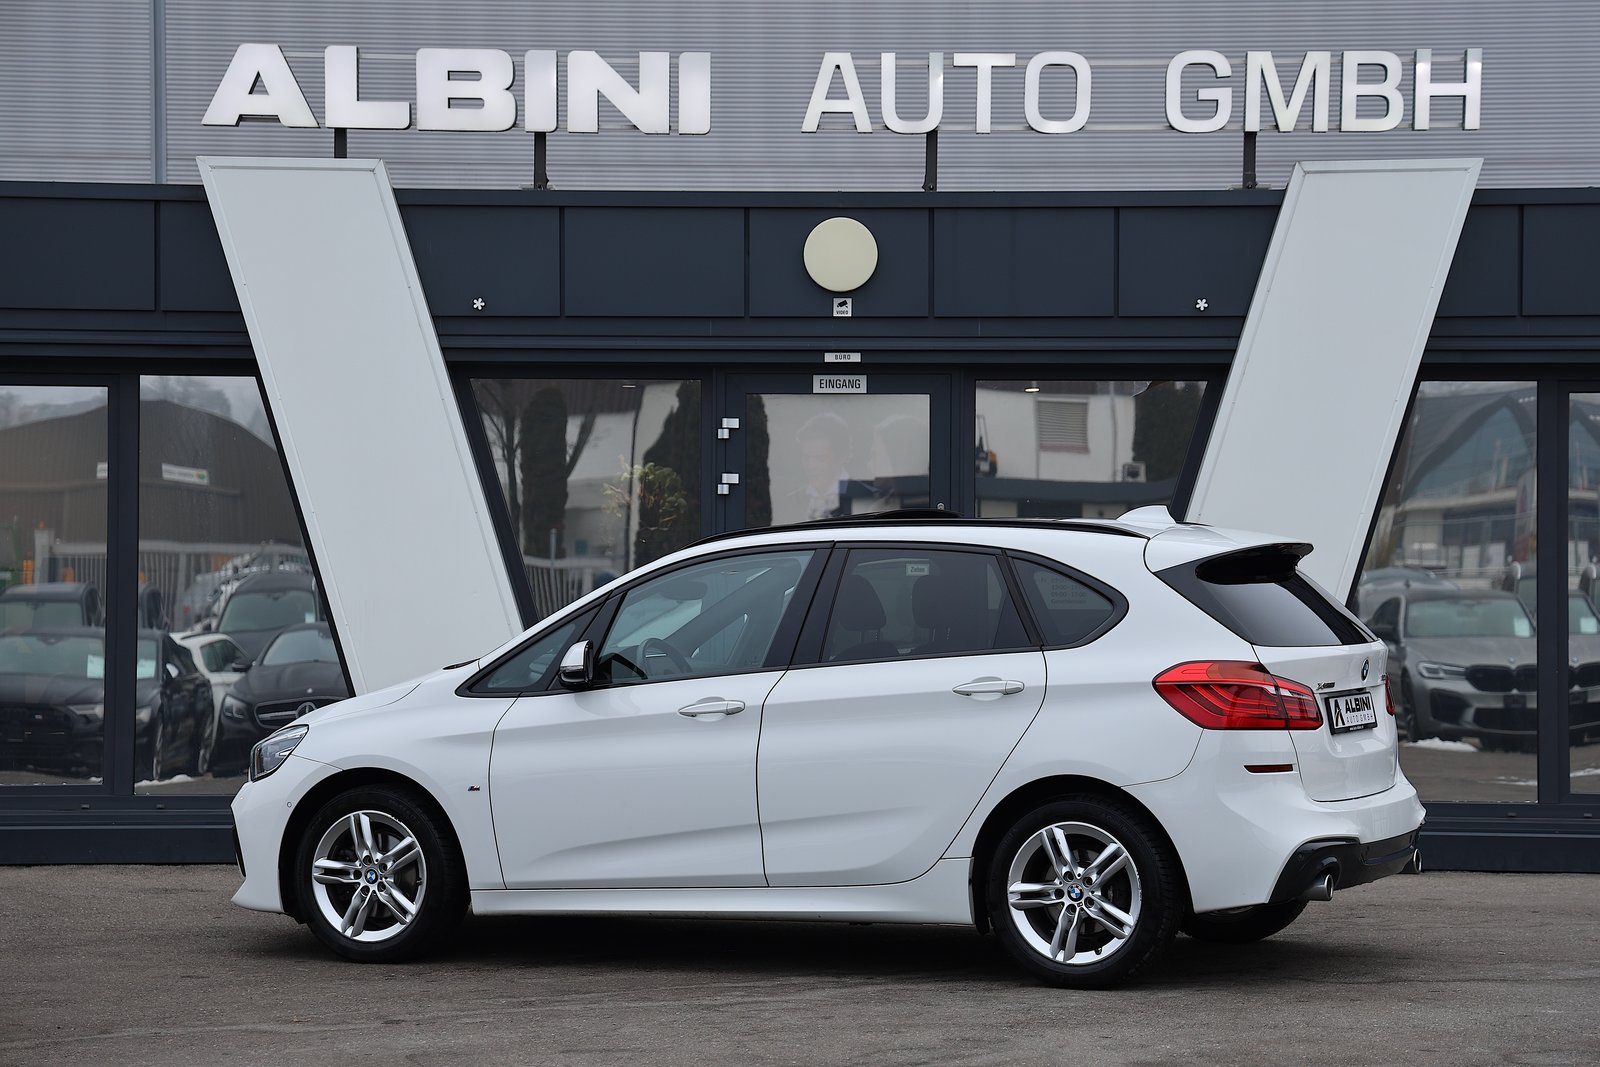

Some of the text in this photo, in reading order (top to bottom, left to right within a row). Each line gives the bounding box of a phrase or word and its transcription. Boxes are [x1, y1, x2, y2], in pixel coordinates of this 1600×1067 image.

[201, 43, 1483, 136] ALBINI AUTO GMBH
[819, 378, 861, 389] EINGANG
[1345, 696, 1372, 714] ALBINI
[1346, 714, 1359, 724] AUTO
